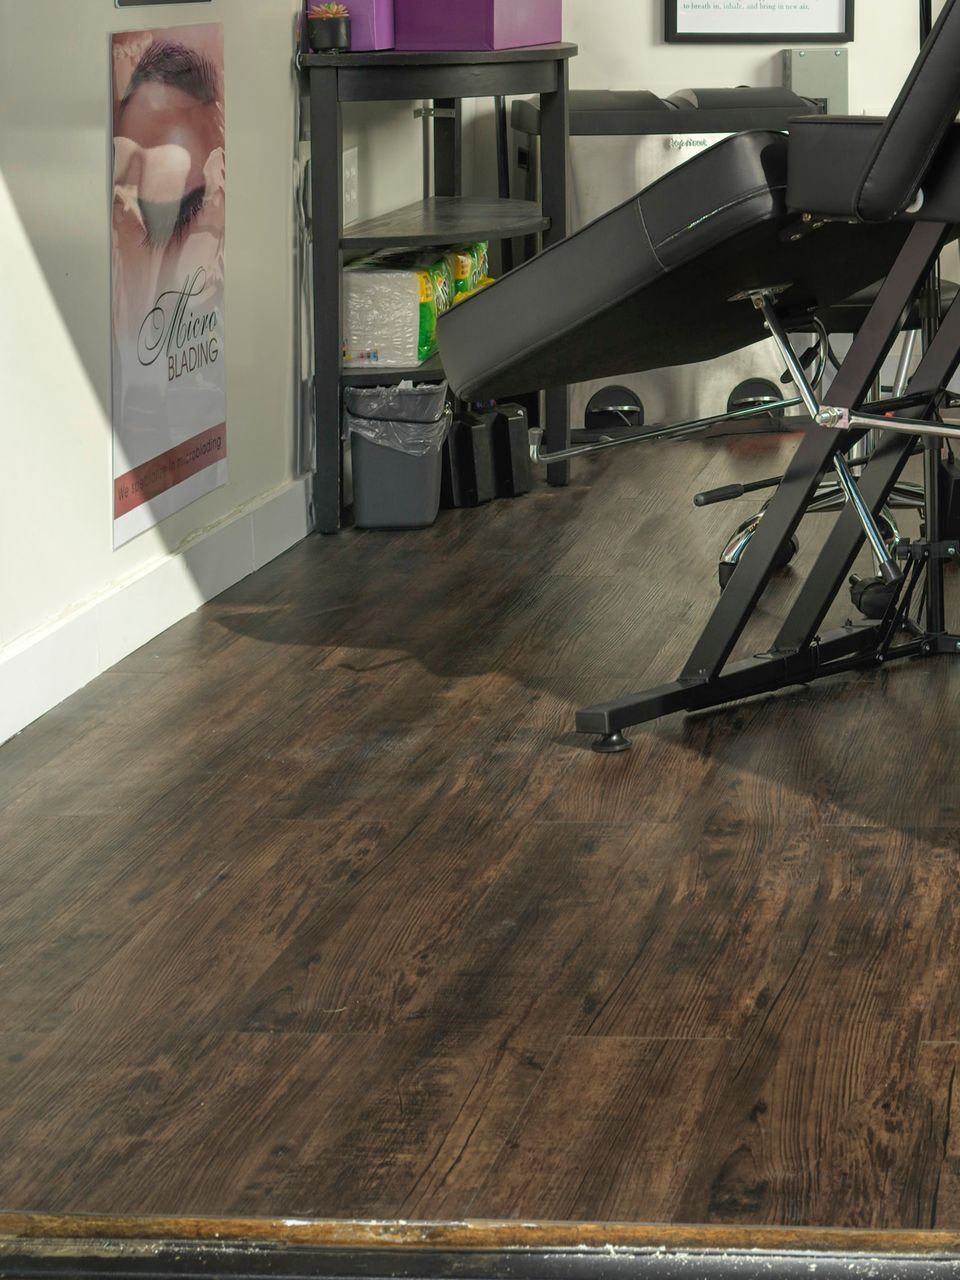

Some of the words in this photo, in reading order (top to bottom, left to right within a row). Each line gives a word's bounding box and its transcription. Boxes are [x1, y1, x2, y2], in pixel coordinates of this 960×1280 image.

[746, 2, 758, 10] and
[137, 265, 217, 367] Micro
[168, 337, 219, 381] BLADING
[118, 483, 129, 502] We
